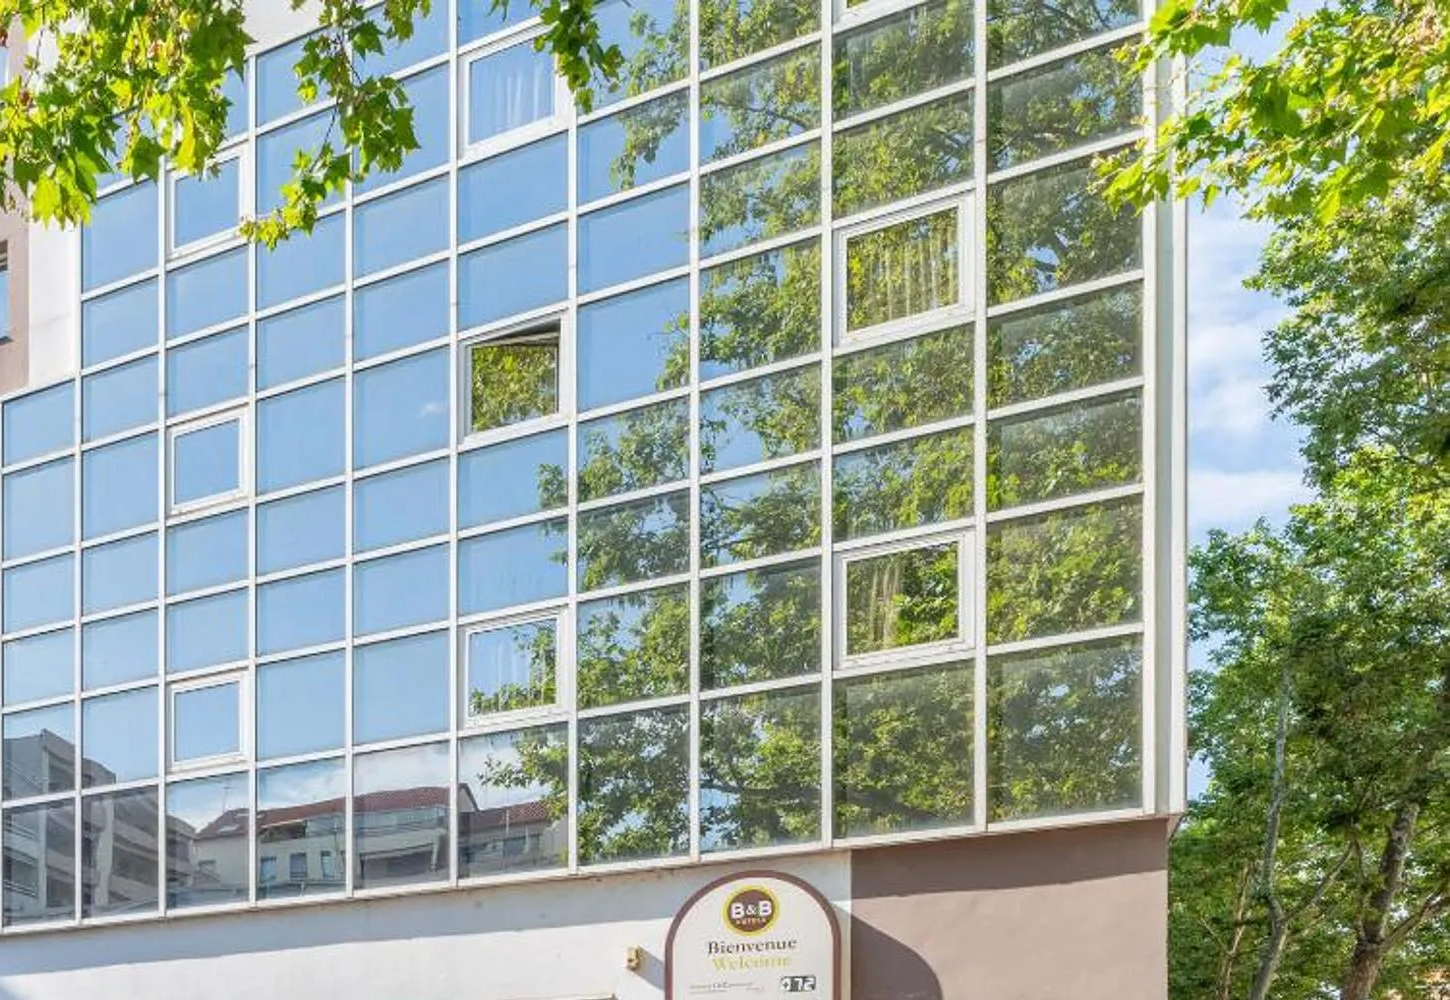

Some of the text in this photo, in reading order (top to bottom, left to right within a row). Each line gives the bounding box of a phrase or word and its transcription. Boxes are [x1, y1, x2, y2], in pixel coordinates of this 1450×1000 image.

[731, 900, 772, 919] B&B
[708, 939, 798, 954] Bienvenue
[712, 955, 790, 972] Welcome
